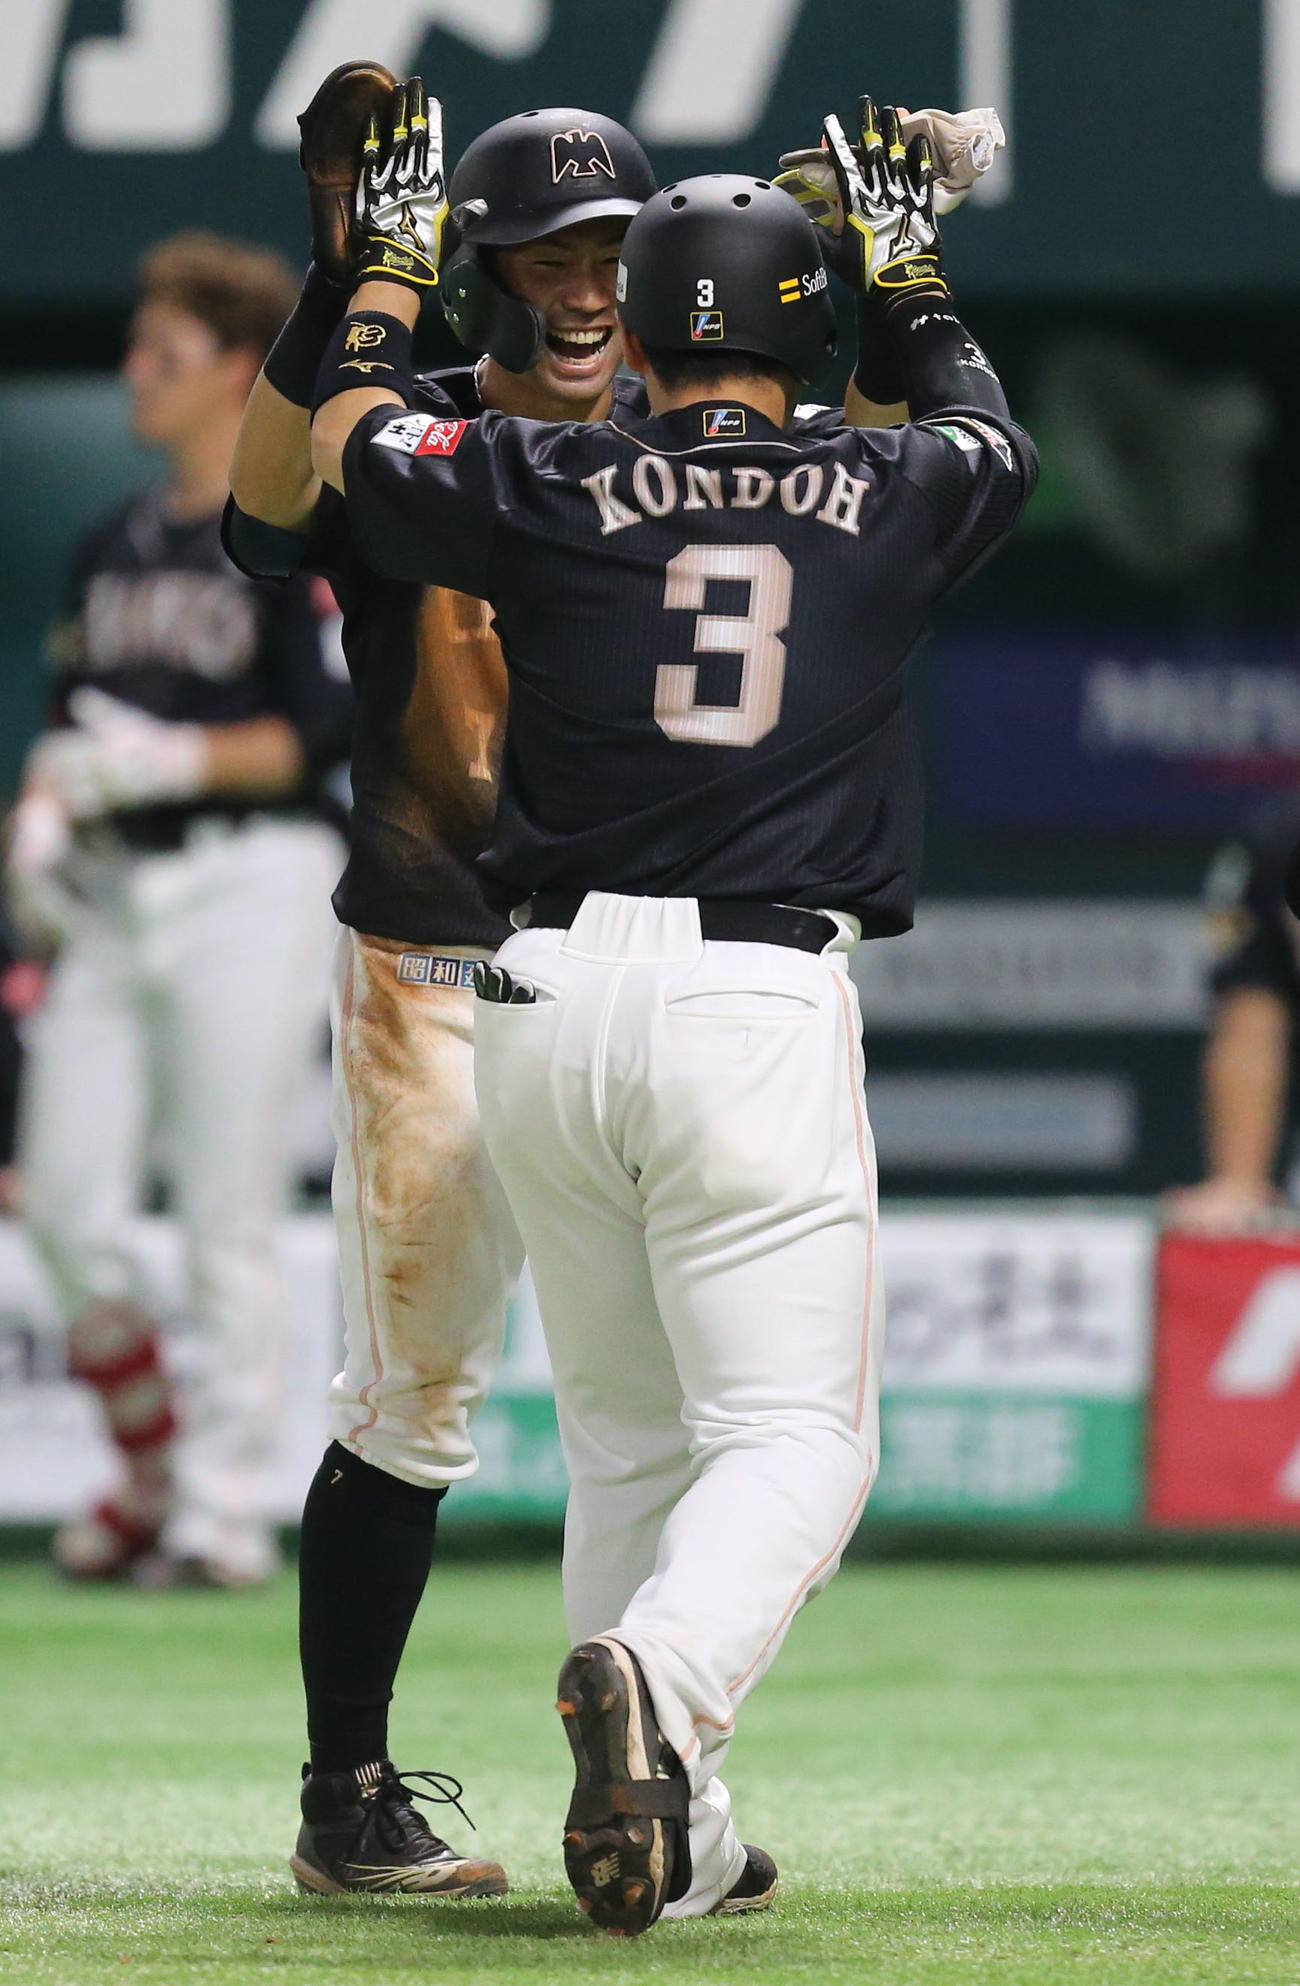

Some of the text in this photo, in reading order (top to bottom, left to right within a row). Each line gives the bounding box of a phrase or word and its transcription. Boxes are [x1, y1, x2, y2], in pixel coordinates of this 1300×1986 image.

[697, 278, 714, 308] 3
[719, 418, 741, 427] NPB
[580, 453, 871, 537] KONDOH
[653, 544, 794, 749] 3
